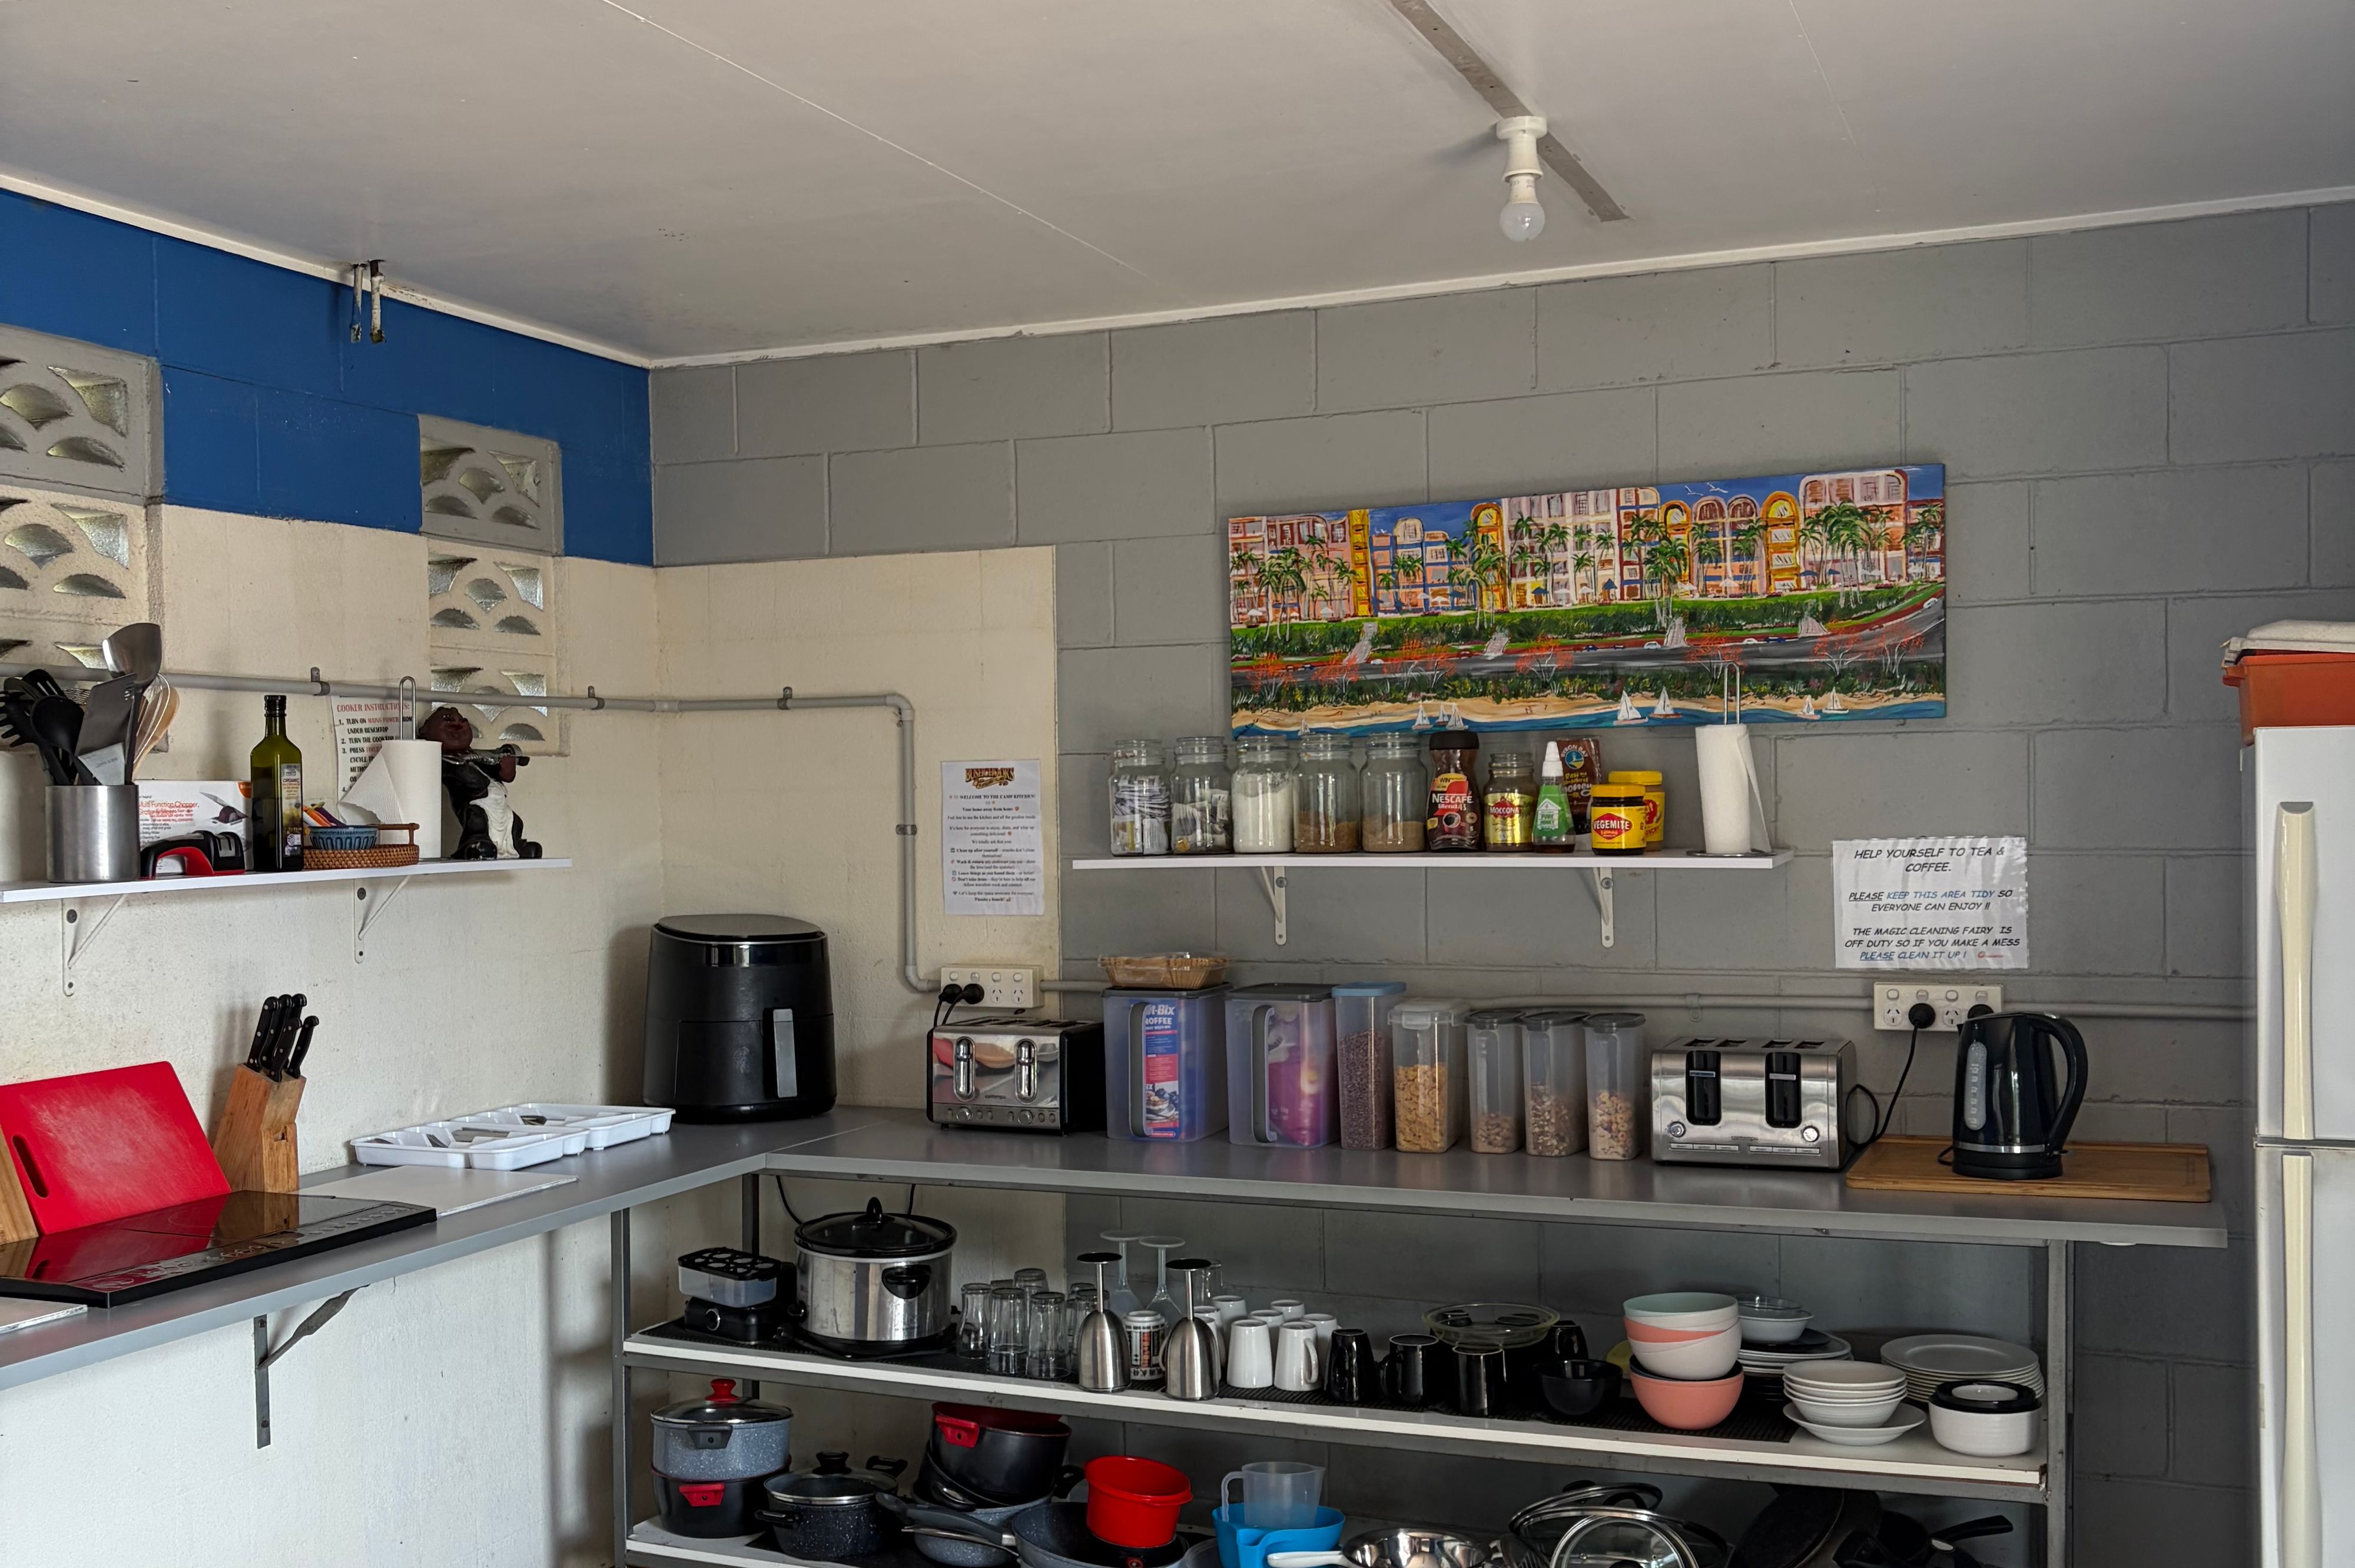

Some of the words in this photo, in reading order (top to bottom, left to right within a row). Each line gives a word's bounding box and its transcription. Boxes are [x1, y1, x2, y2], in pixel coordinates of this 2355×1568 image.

[337, 704, 363, 712] COOKER
[365, 703, 410, 711] INSTRUCTIOS:
[1594, 820, 1630, 830] VEGEMITE
[1854, 849, 1882, 859] HELP
[1886, 848, 1945, 858] YOURSELF
[1950, 848, 1966, 857] TO
[1971, 847, 1992, 856] TEA
[1996, 846, 2005, 855] &
[1905, 862, 1952, 872] COFFEE.
[1849, 892, 1885, 901] PLEASE
[1886, 891, 1910, 899] KEEP
[1913, 891, 1938, 899] THIS
[1941, 891, 1966, 899] AREA
[1971, 890, 1995, 899] TIDY
[1998, 889, 2013, 898] SO
[1871, 903, 1922, 912] EVERYONE
[1925, 903, 1945, 911] CAN
[1948, 902, 1981, 911] ENJOY
[1853, 928, 1872, 936] THE
[1873, 927, 1907, 936] MAGIC
[1909, 927, 1960, 935] CLEANING
[1962, 926, 1994, 935] FAIRY
[1999, 926, 2012, 934] IS
[1866, 939, 1893, 948] DUTY
[1928, 939, 1948, 947] YOU
[1951, 939, 1979, 947] MAKE
[1982, 938, 1989, 946] A
[1992, 938, 2021, 946] MESS
[1859, 952, 1895, 961] PLEASE
[1898, 951, 1929, 959] CLEAN
[1948, 951, 1961, 959] UP
